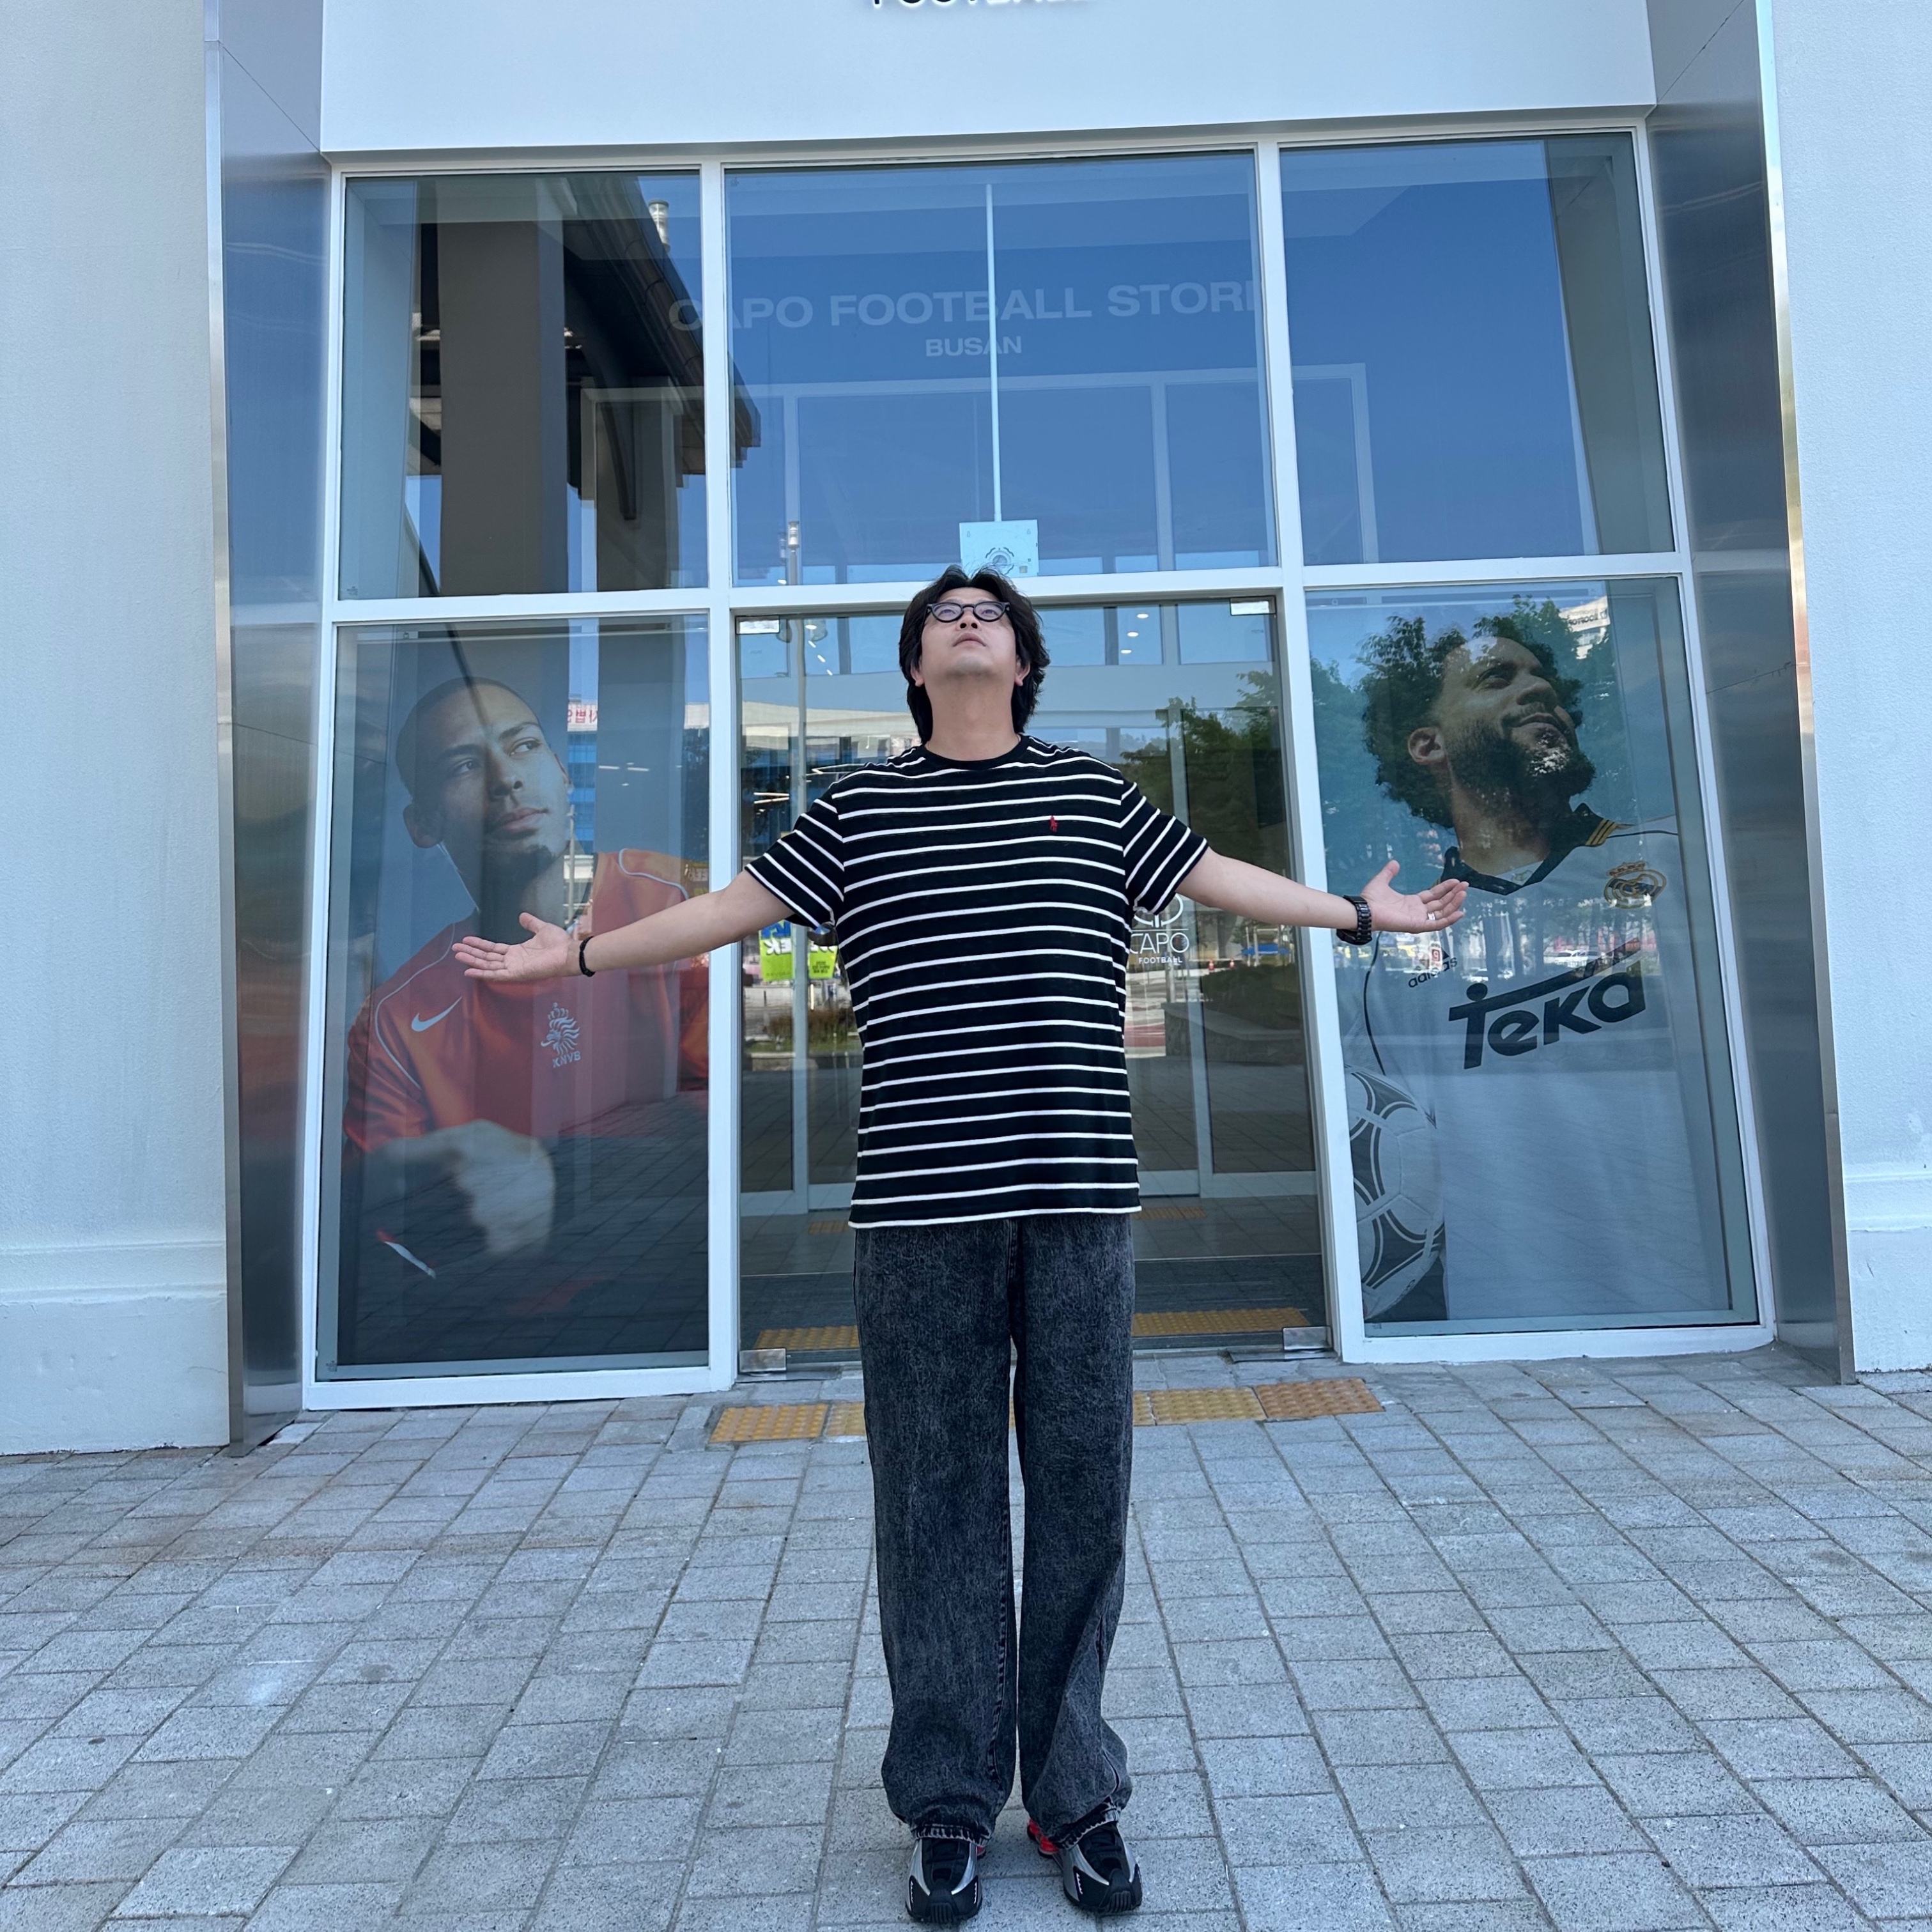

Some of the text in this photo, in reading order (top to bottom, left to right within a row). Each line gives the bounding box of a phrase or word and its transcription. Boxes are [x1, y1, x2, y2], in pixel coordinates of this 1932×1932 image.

[830, 288, 1092, 326] FOOTBALL
[925, 336, 1022, 357] BUSAN
[552, 1050, 580, 1068] KNVB
